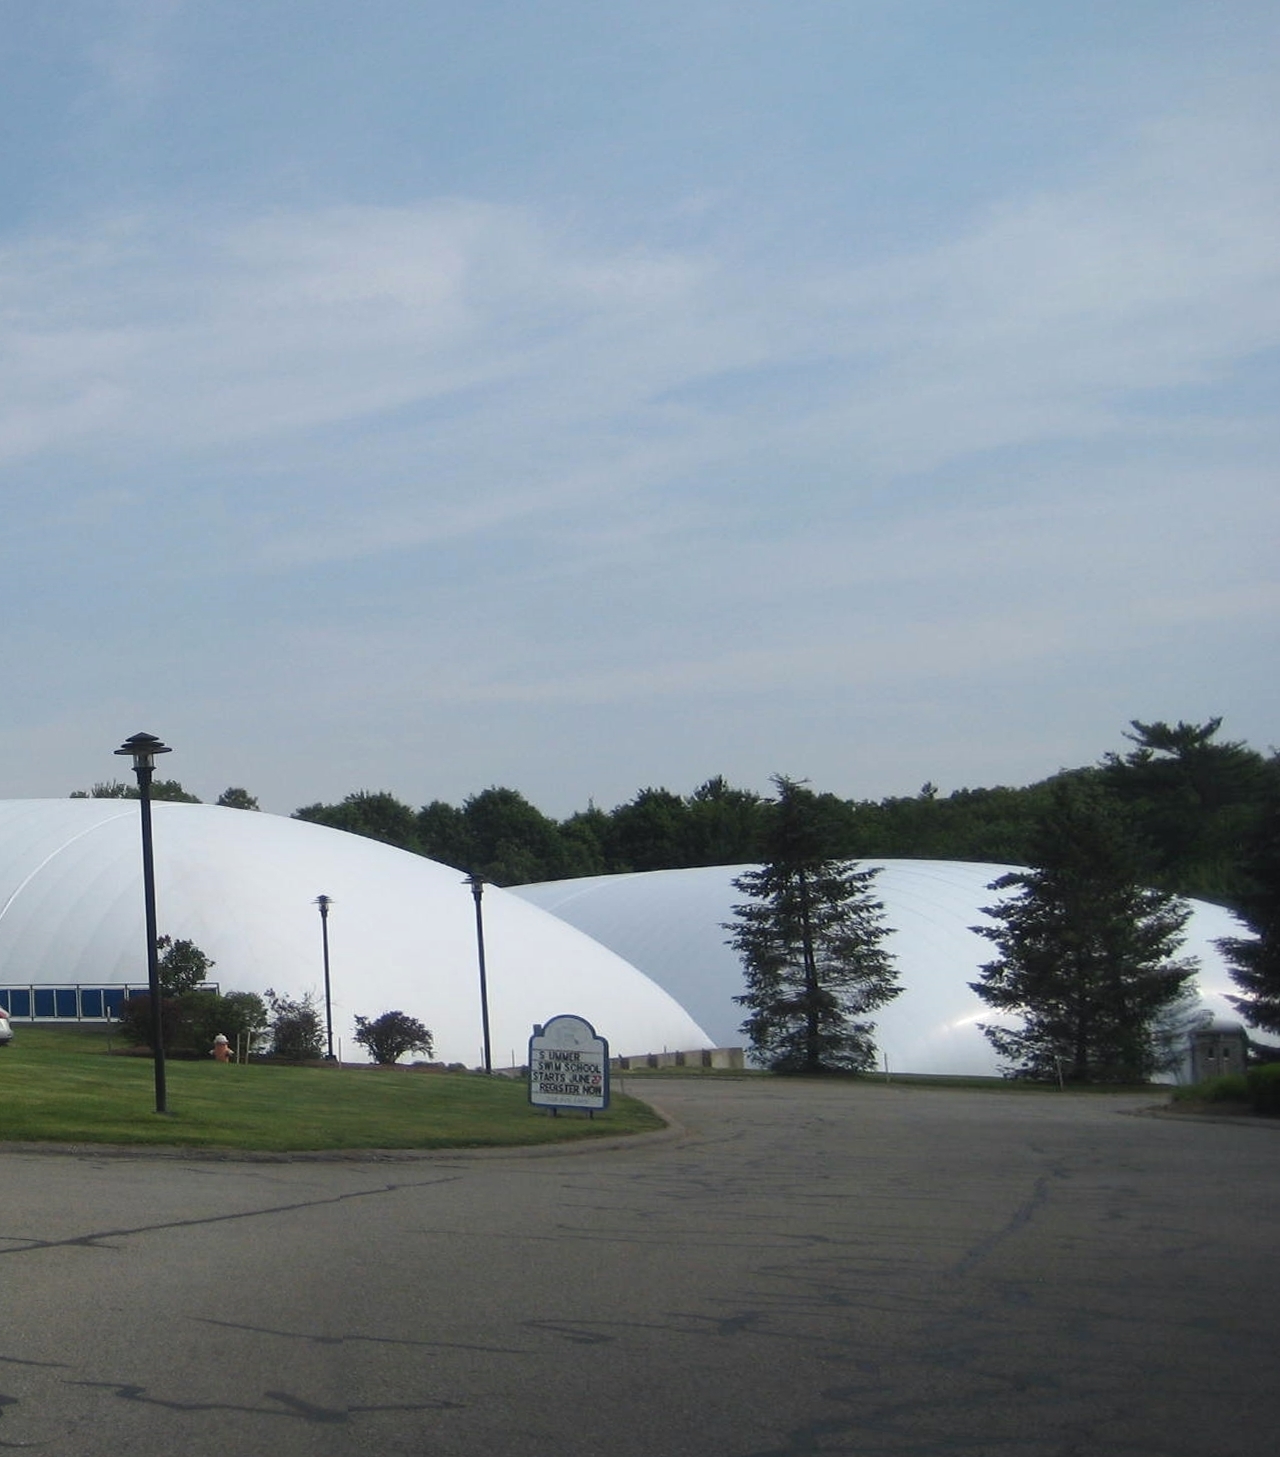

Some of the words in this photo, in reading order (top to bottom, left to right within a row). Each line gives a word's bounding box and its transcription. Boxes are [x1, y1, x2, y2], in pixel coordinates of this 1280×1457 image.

[538, 1061, 561, 1071] SWIM
[564, 1063, 601, 1073] SCHOOL
[533, 1072, 566, 1082] STARTS
[570, 1074, 590, 1084] JUNE
[539, 1083, 580, 1094] REGISTER
[582, 1086, 602, 1096] NOW
